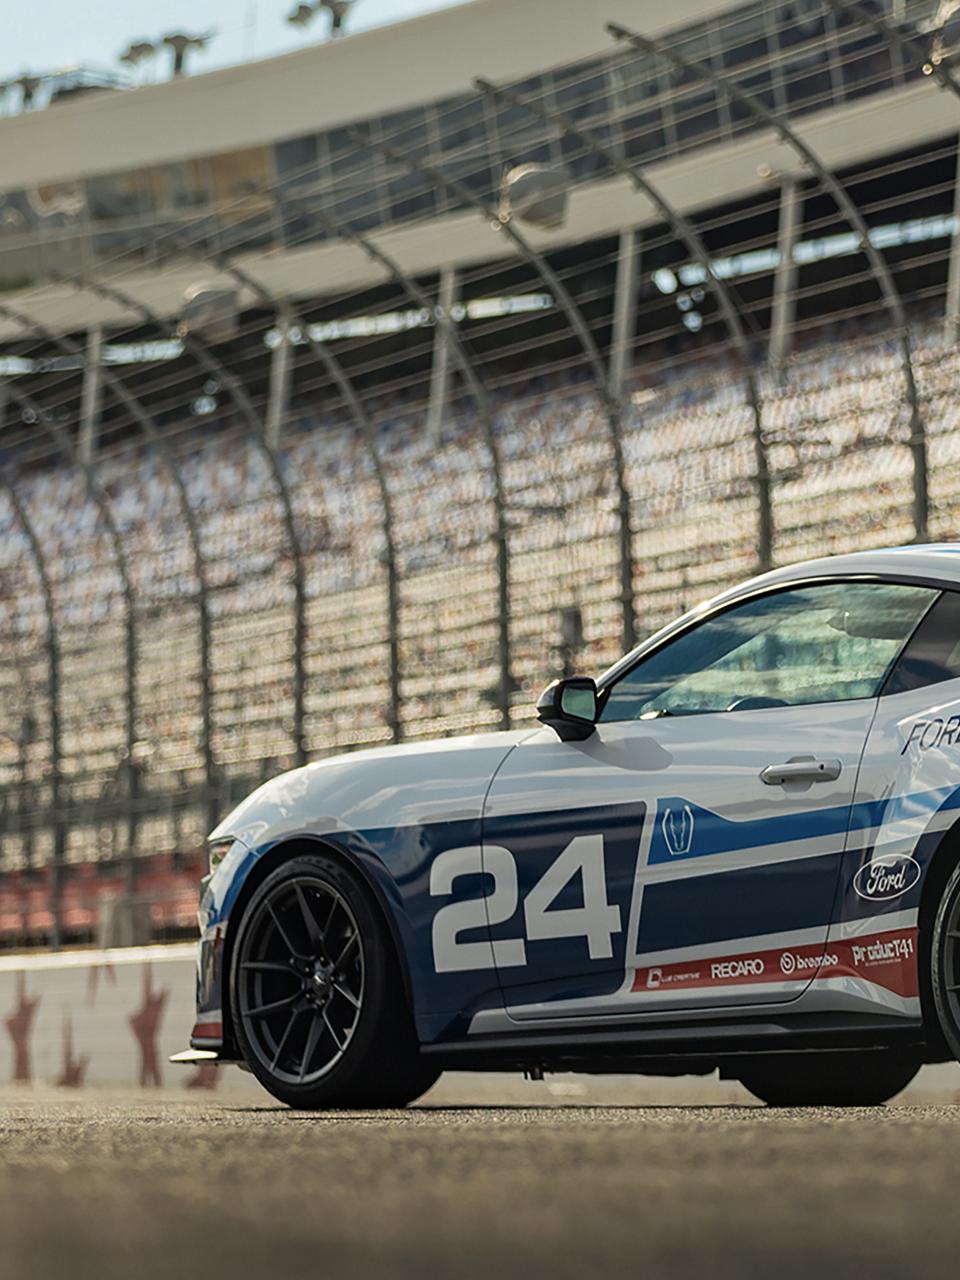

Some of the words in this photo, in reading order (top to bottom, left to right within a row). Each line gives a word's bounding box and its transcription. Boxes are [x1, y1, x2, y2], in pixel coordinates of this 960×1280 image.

[866, 860, 906, 895] Ford
[429, 833, 623, 974] 24
[711, 959, 765, 980] RECARO
